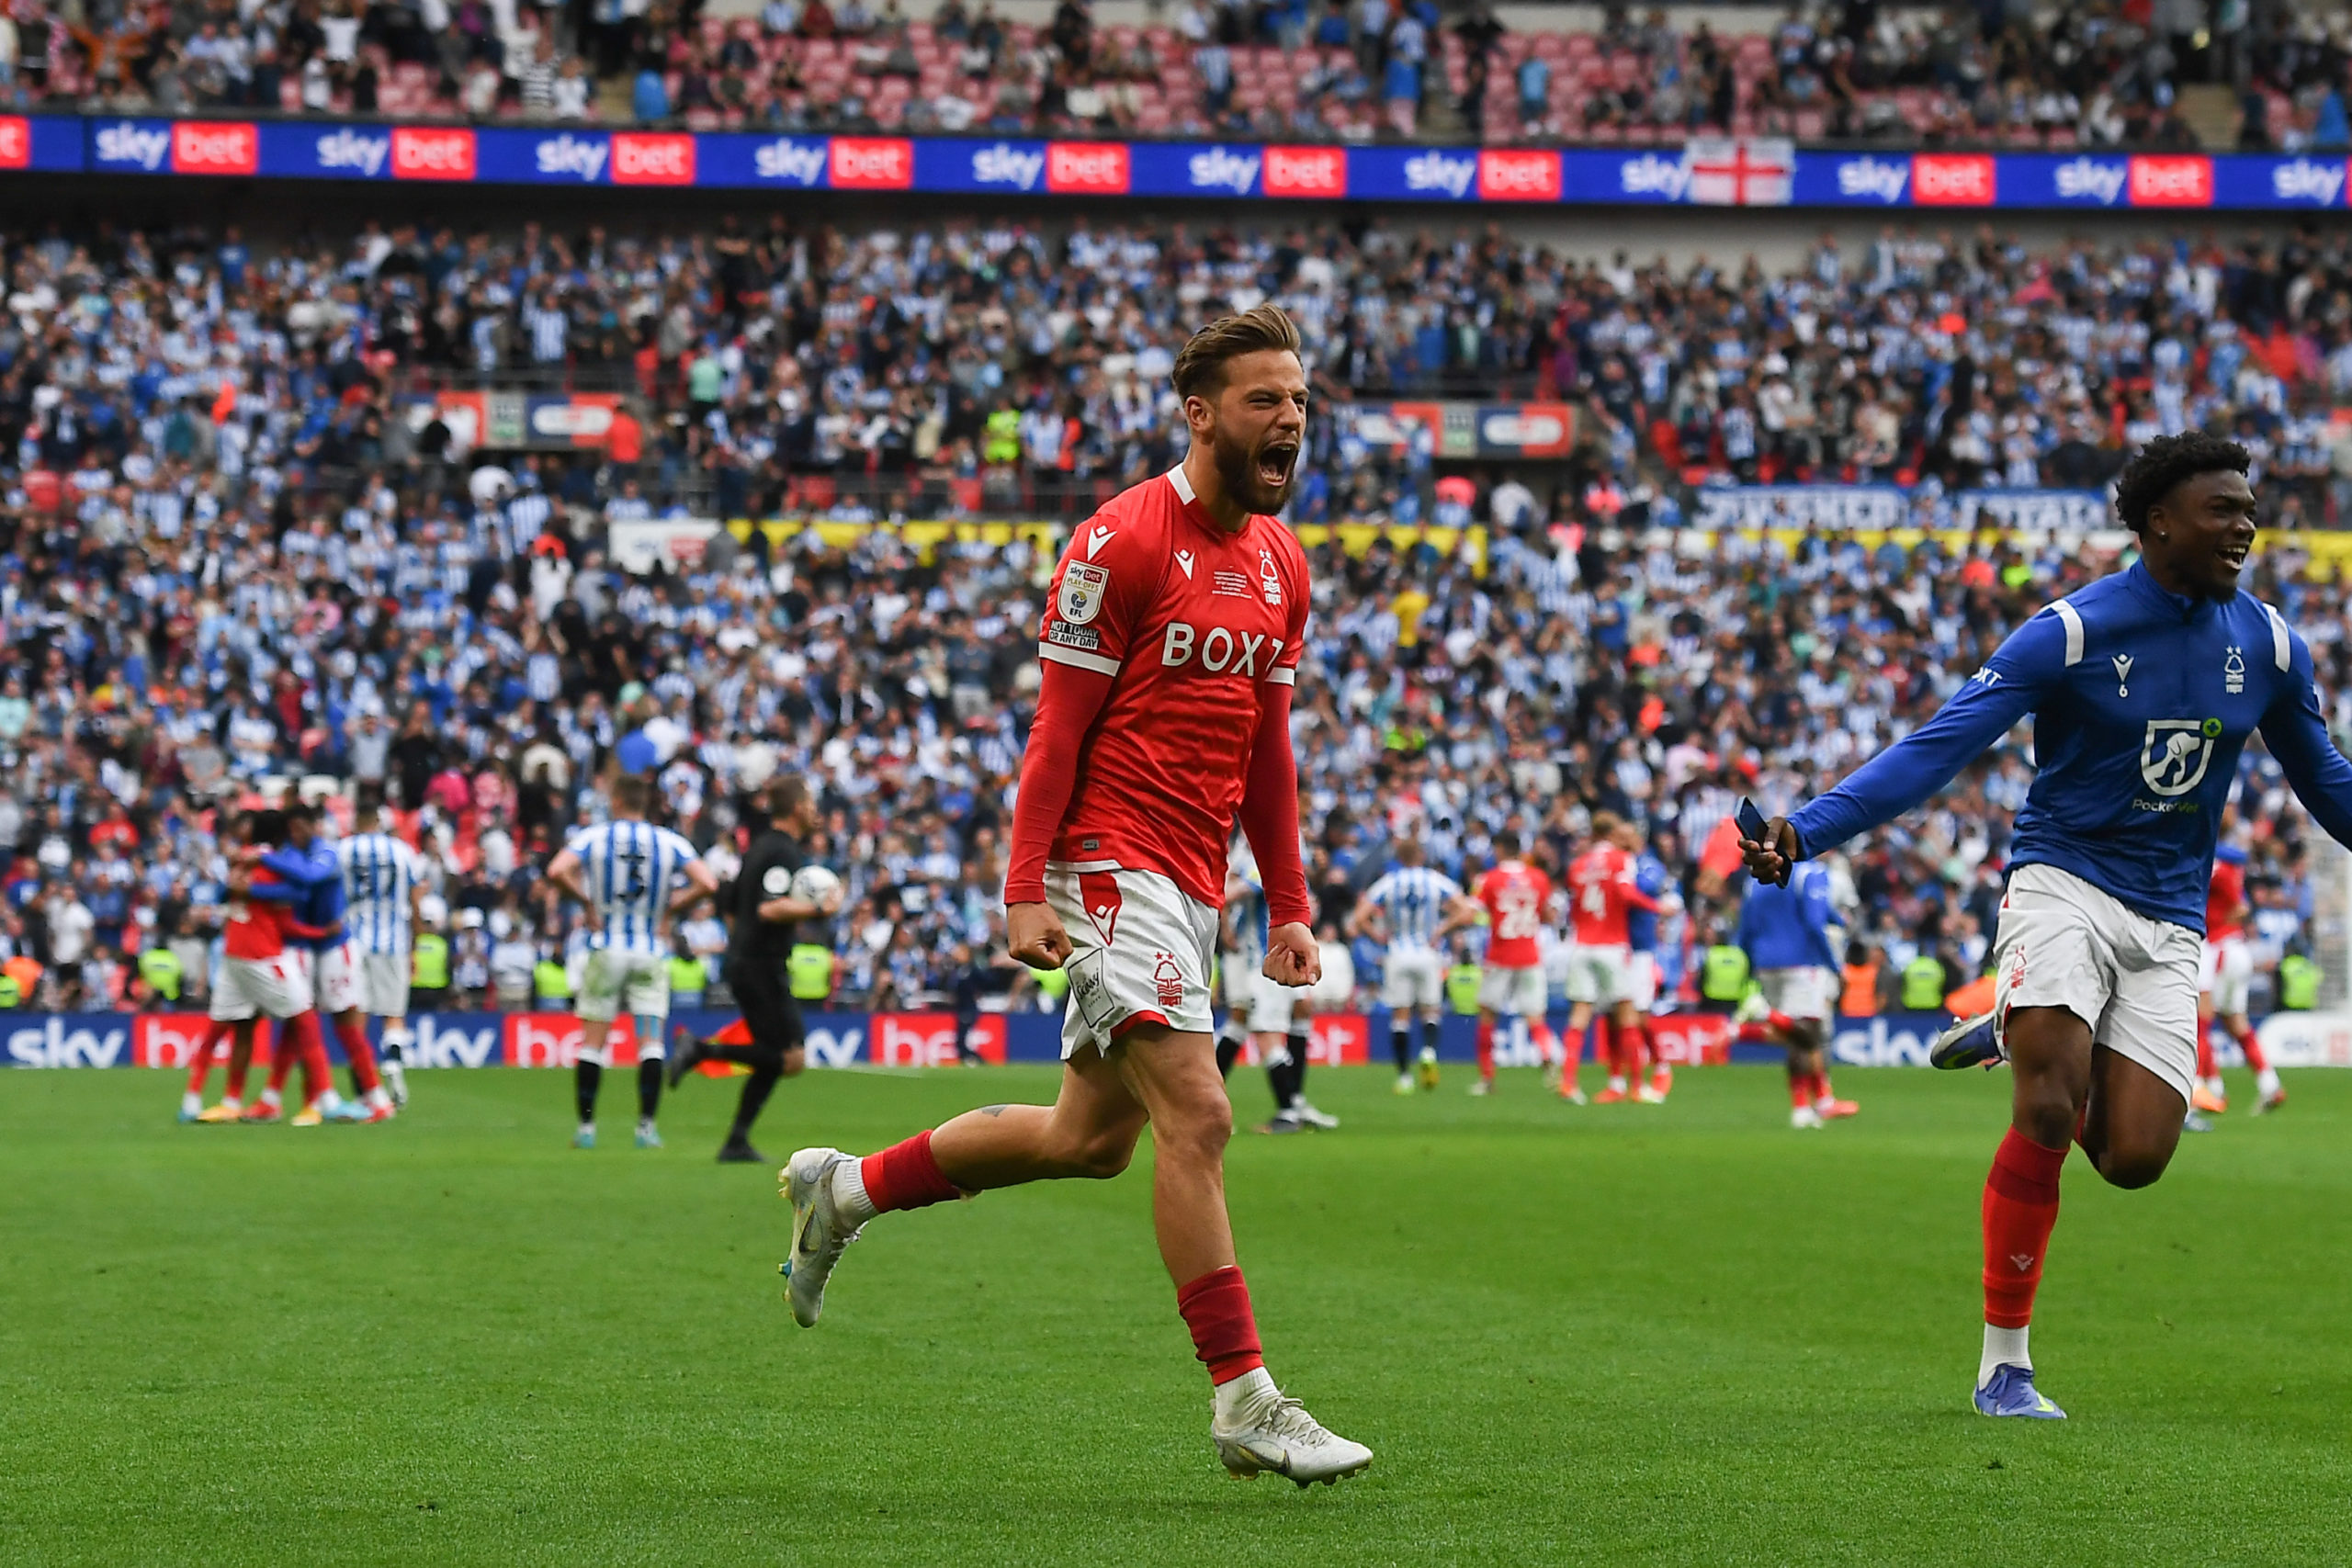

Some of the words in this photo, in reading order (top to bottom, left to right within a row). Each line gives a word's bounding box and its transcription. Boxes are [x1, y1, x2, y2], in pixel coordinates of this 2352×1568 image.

[96, 122, 171, 171] sky
[177, 128, 248, 165] bet
[316, 128, 390, 176] sky
[396, 133, 466, 171] bet
[535, 133, 607, 182] sky
[616, 139, 686, 176] bet
[753, 138, 826, 186] sky
[833, 143, 903, 180] bet
[971, 142, 1045, 191] sky
[1050, 148, 1121, 186] bet
[1188, 147, 1261, 195] sky
[1267, 152, 1338, 189] bet
[1404, 152, 1476, 198] sky
[1482, 156, 1553, 192] bet
[1838, 157, 1909, 204] sky
[2054, 158, 2127, 206] sky
[2272, 159, 2345, 206] sky
[1069, 566, 1083, 578] sky
[1085, 570, 1102, 581] bet
[1051, 620, 1067, 631] NOT
[1068, 625, 1099, 638] TODAY
[1069, 607, 1082, 618] EFL
[1059, 634, 1079, 645] ANY
[1080, 637, 1097, 649] DAY
[2119, 684, 2129, 698] 6
[7, 1016, 127, 1069] sky
